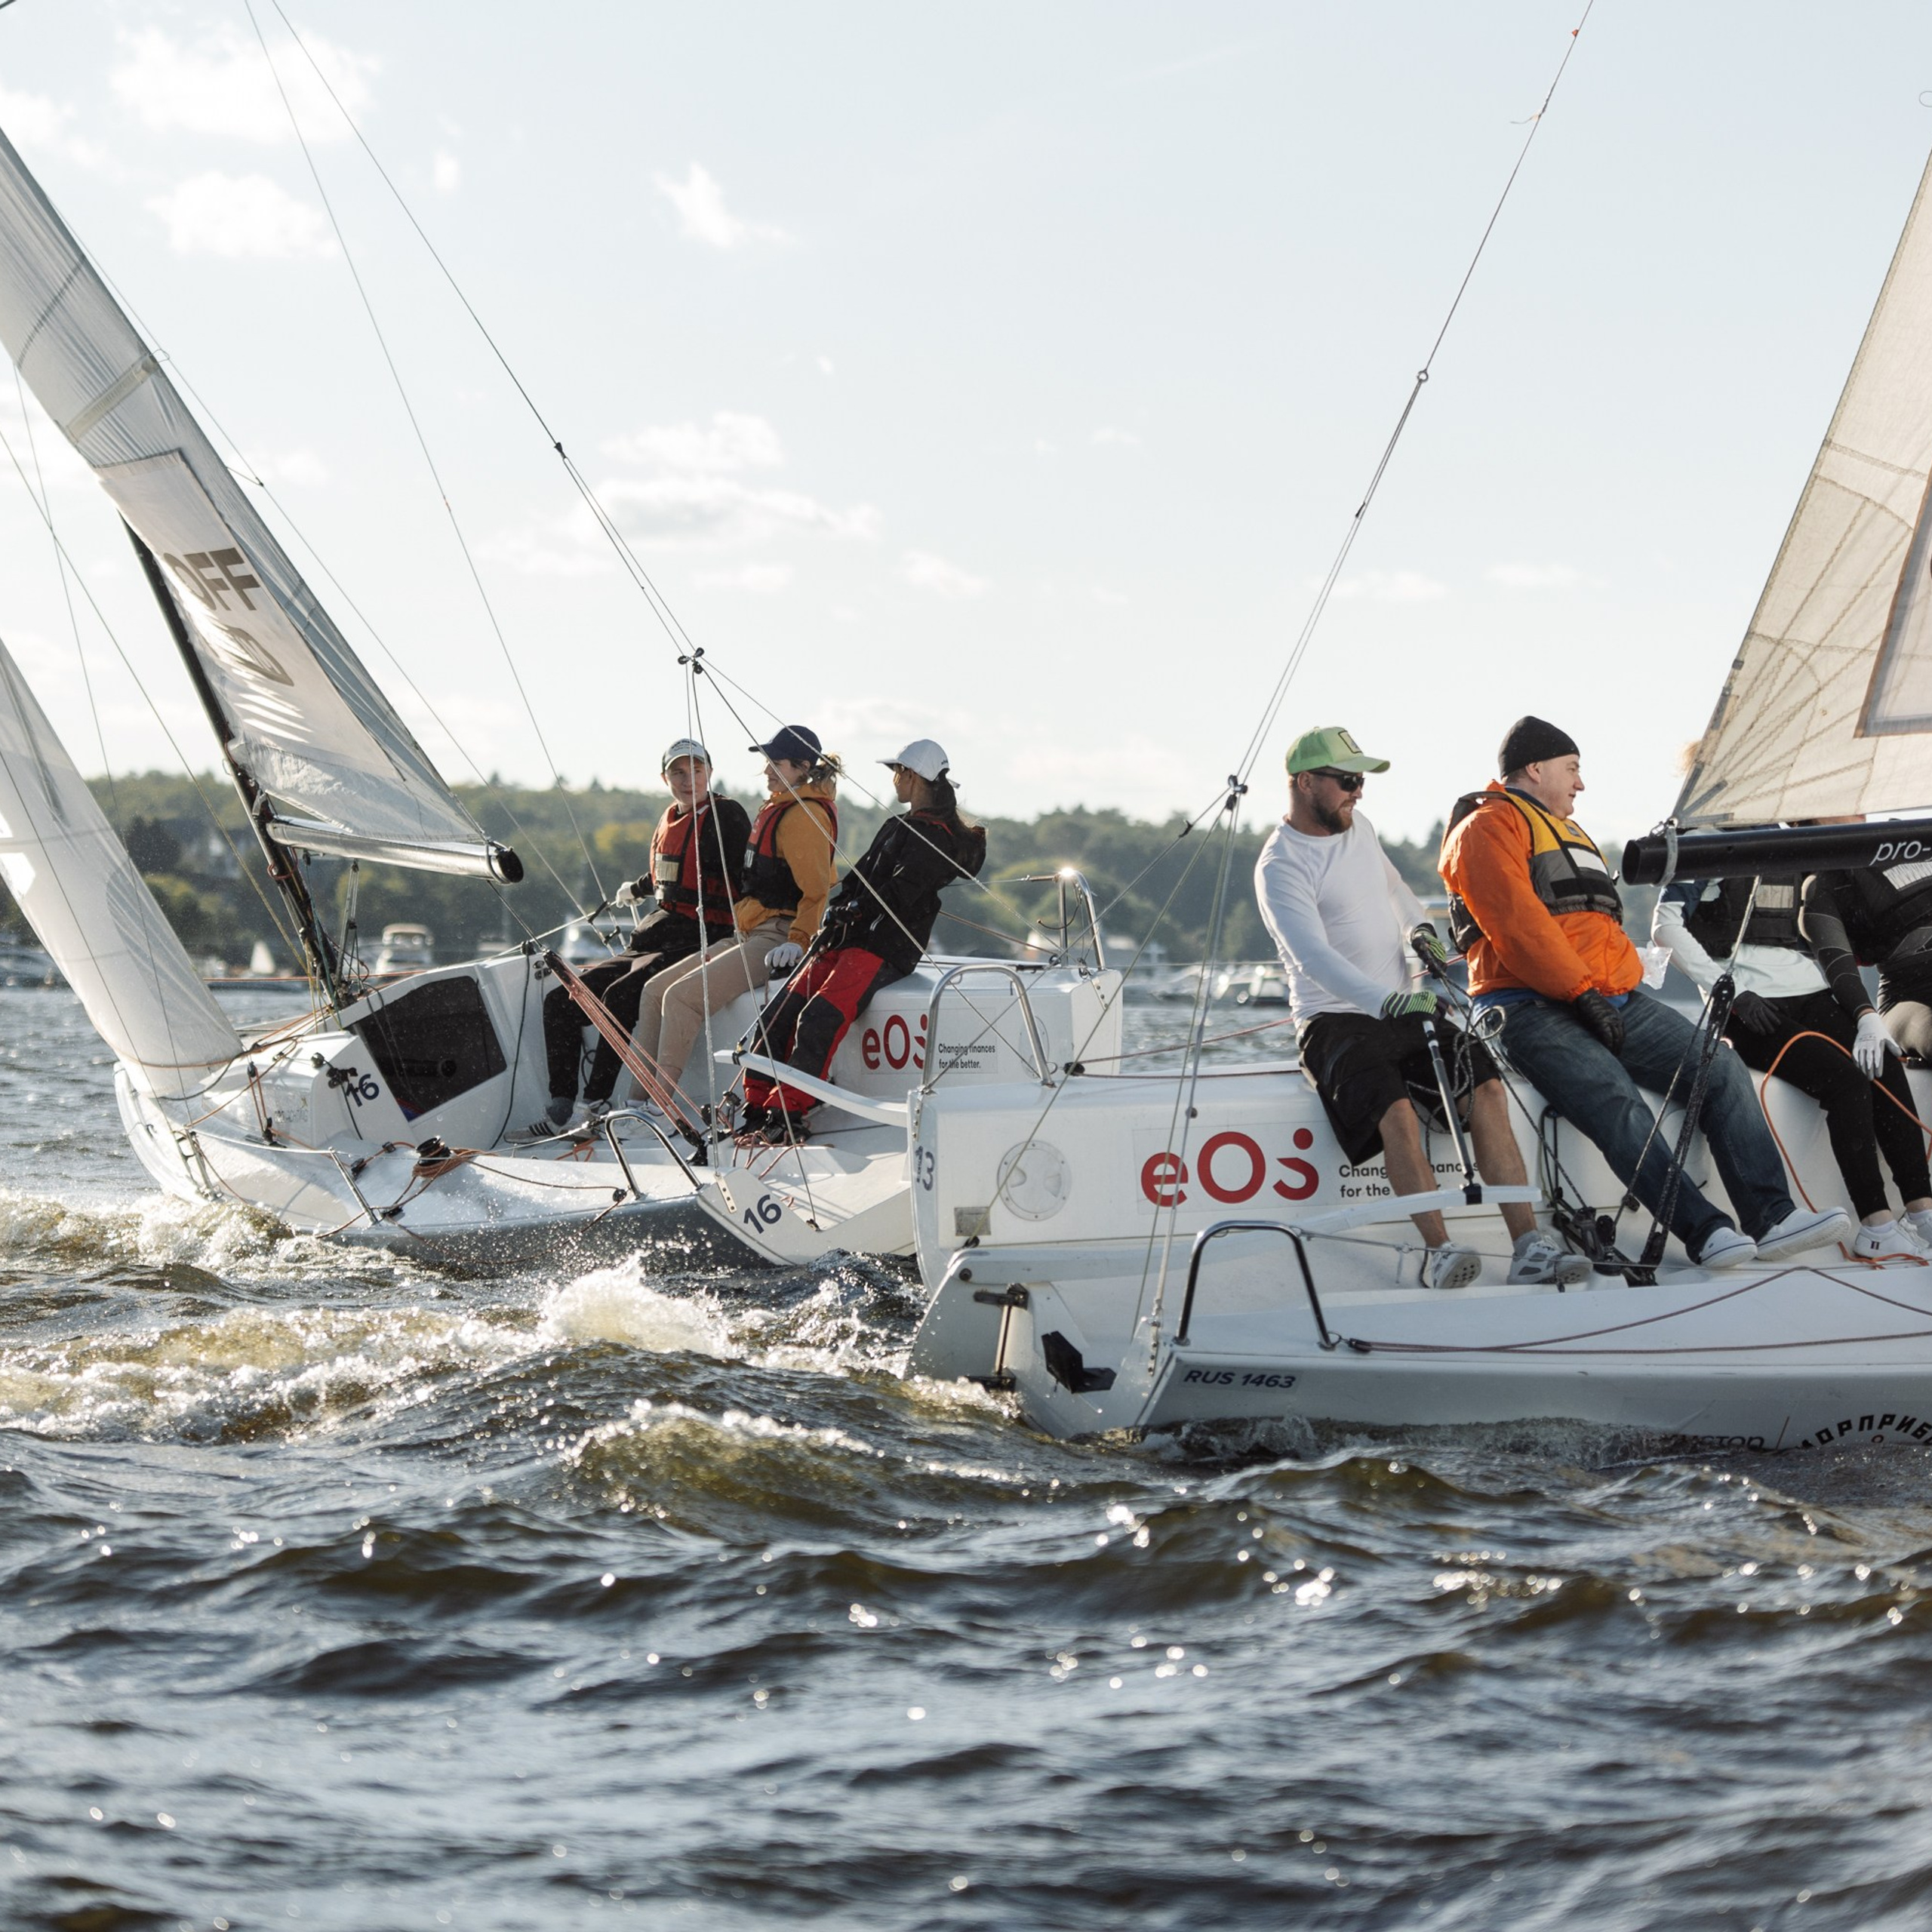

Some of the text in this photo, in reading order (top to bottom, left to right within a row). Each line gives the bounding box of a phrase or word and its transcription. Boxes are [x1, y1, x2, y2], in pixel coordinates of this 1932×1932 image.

[938, 1043, 996, 1056] Changing finances
[939, 1058, 981, 1069] for the better.
[346, 1073, 380, 1107] 16
[915, 1145, 935, 1191] 13
[1340, 1183, 1390, 1198] for the
[743, 1194, 782, 1234] 16
[1183, 1370, 1297, 1389] RUS 1463
